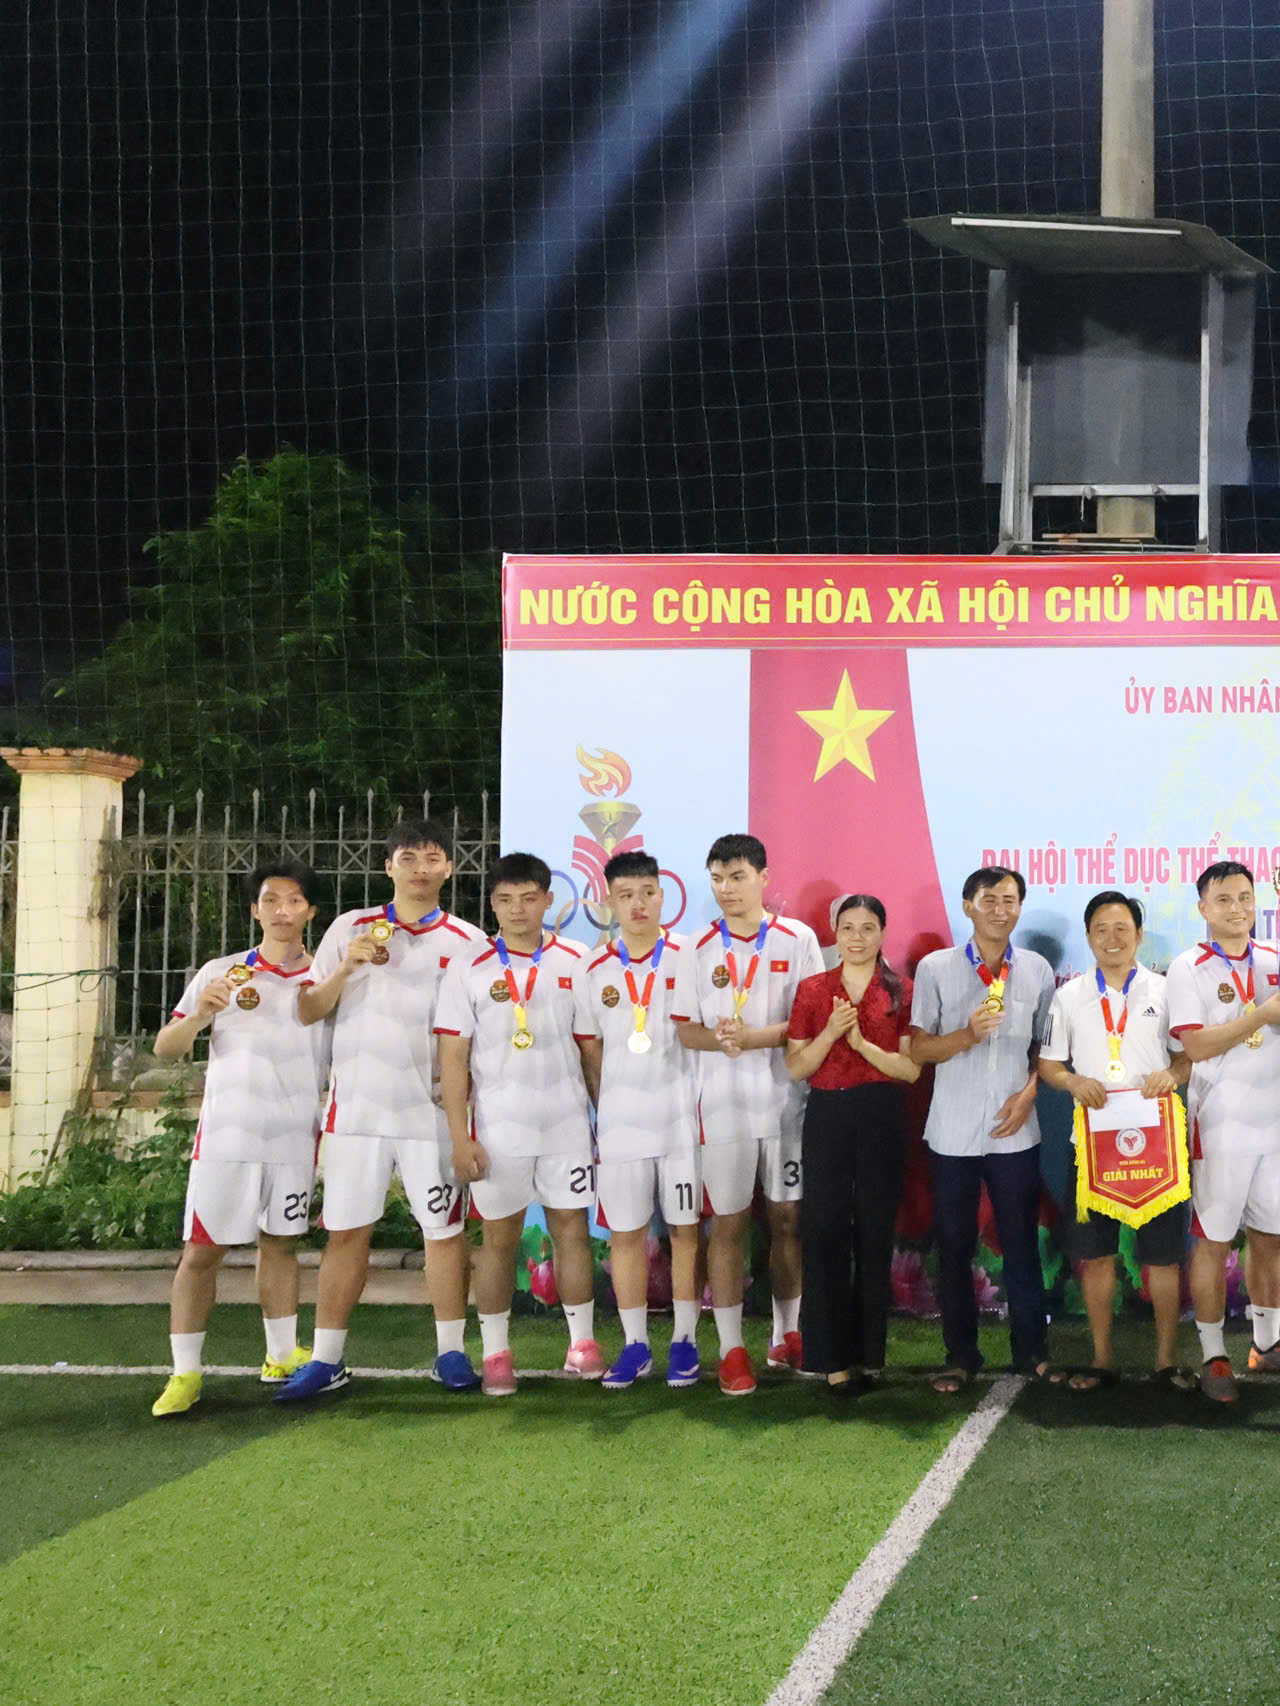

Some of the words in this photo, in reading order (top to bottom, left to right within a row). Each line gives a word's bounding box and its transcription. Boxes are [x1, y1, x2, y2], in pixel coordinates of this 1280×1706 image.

[519, 580, 637, 625] NƯỚC
[652, 579, 771, 632] CỘNG
[785, 578, 873, 624] HÒA
[886, 579, 945, 624] XÃ
[958, 579, 1029, 631] HỘI
[1045, 574, 1131, 623] CHỦ
[1145, 578, 1279, 622] NGHĨA
[1124, 676, 1156, 714] ỦY
[1163, 686, 1213, 714] BAN
[1028, 840, 1067, 893] HỘI
[1074, 833, 1117, 884] THỂ
[1124, 847, 1170, 892] DỤC
[570, 1164, 595, 1194] 21
[784, 1160, 800, 1187] 3
[284, 1192, 307, 1221] 23
[427, 1183, 453, 1214] 23
[675, 1183, 693, 1211] 11
